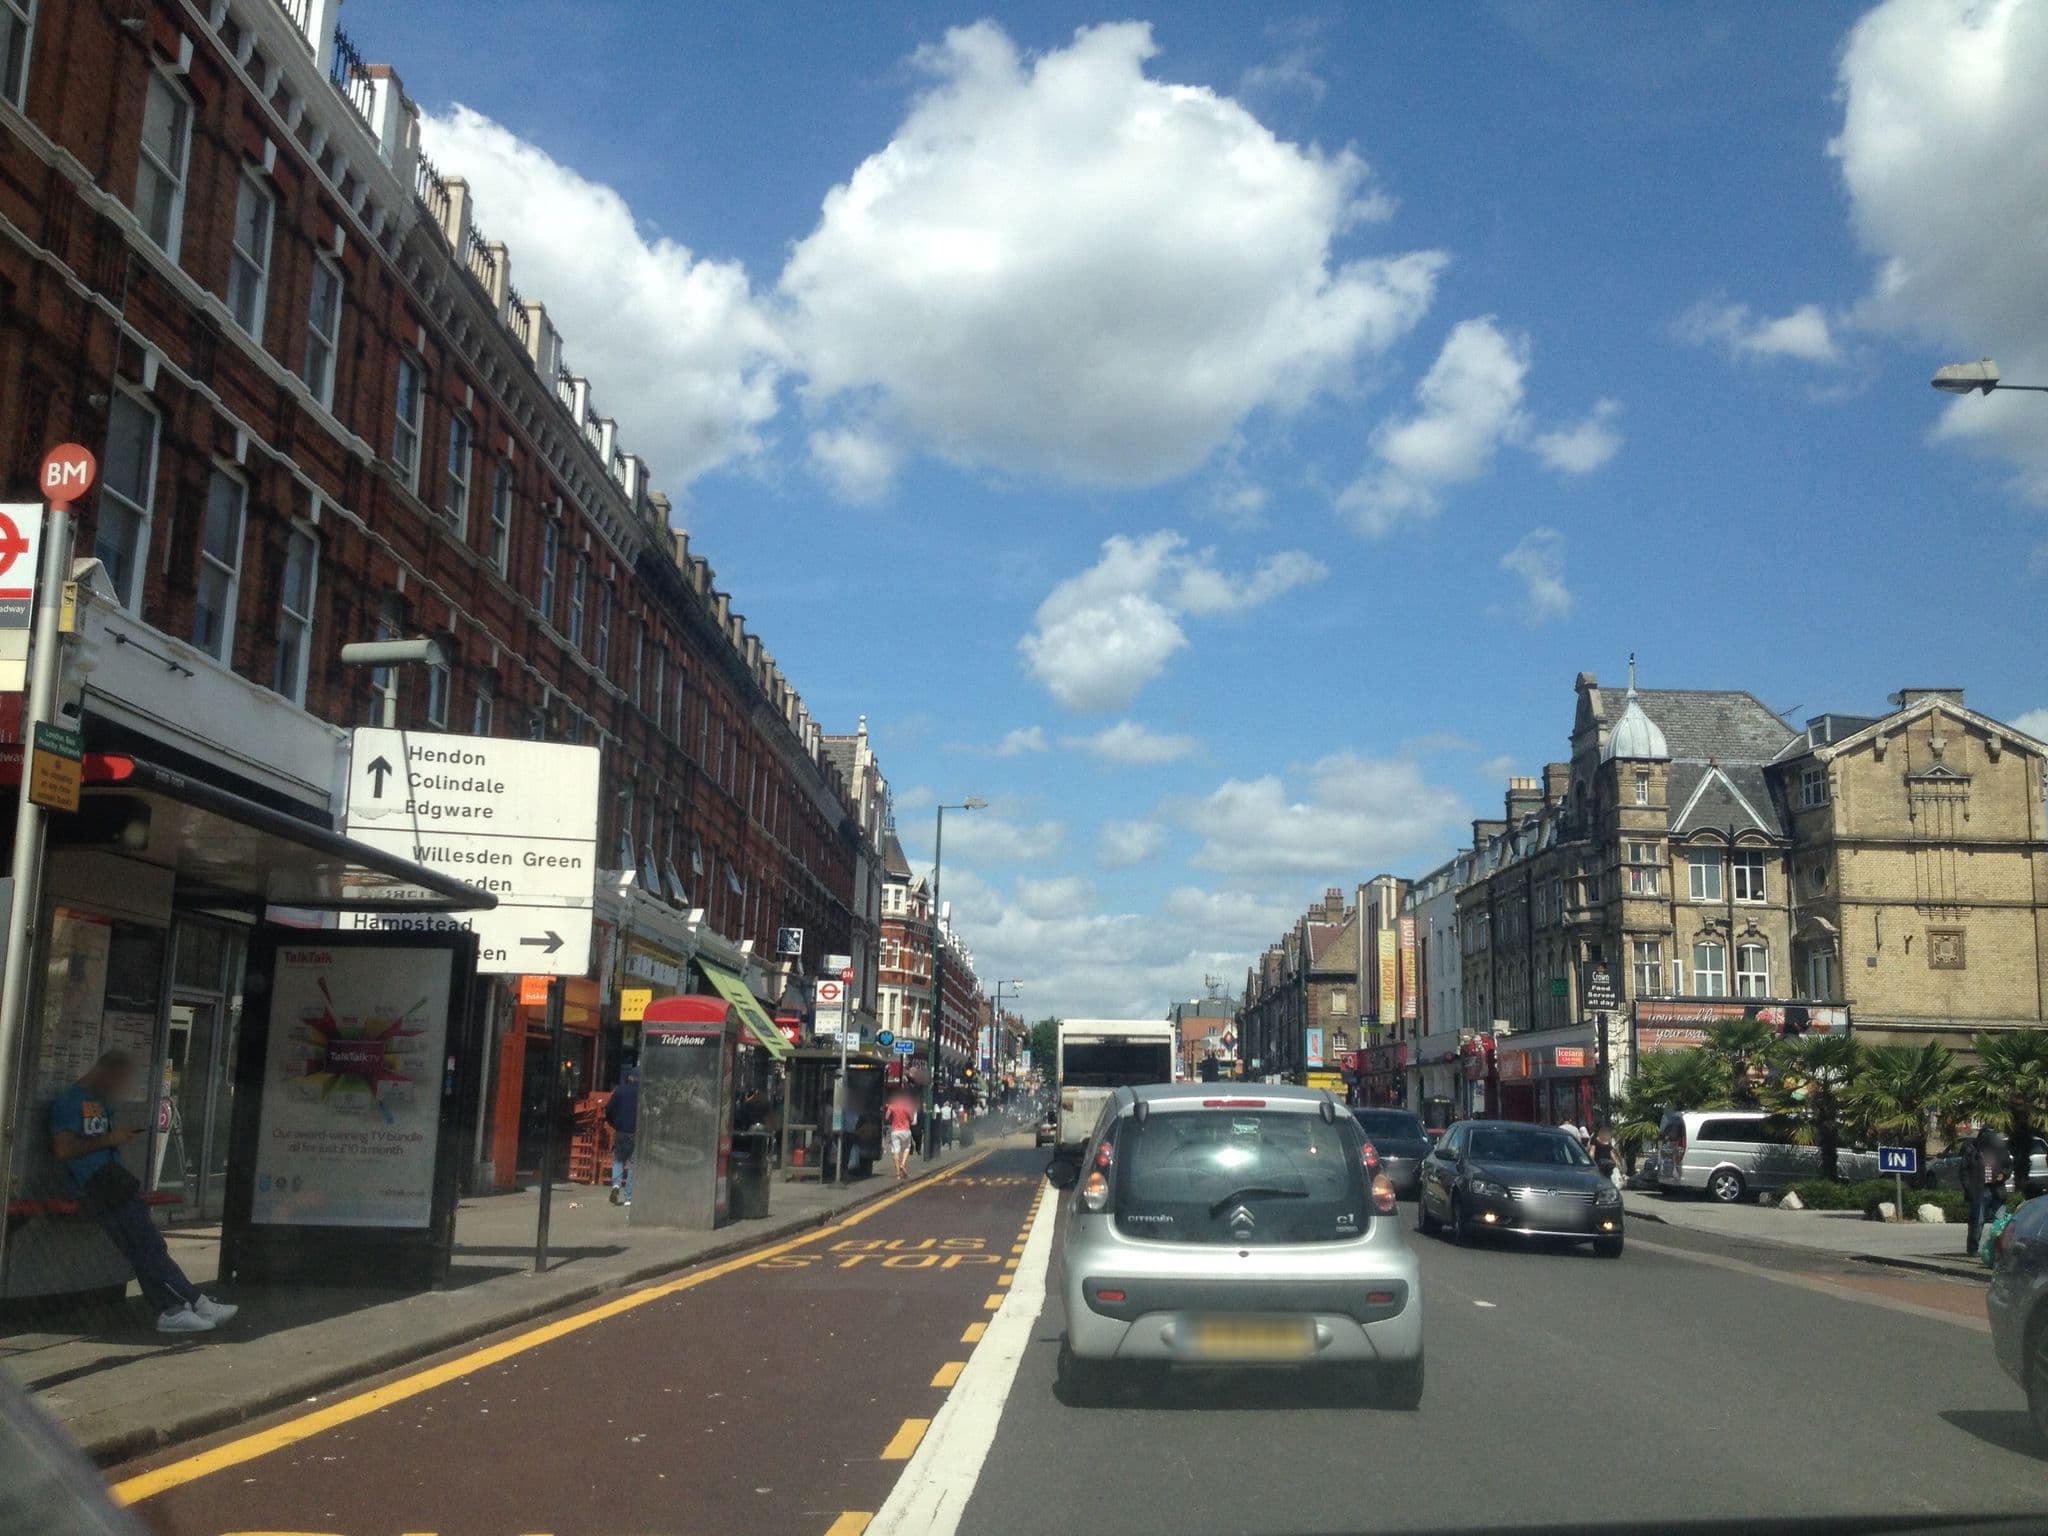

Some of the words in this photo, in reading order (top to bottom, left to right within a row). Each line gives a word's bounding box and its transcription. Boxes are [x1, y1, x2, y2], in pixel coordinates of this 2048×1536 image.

[47, 460, 88, 487] BM
[409, 745, 486, 766] Hendon
[408, 772, 505, 794] Colindale
[405, 799, 494, 819] Edgware
[413, 845, 513, 865] Willesden
[523, 851, 582, 869] Green
[354, 913, 473, 931] Hampstead
[661, 1034, 706, 1046] Telephone
[1654, 1029, 1682, 1046] your
[1888, 1152, 1906, 1167] IN
[829, 1238, 987, 1251] BUS
[756, 1254, 1002, 1269] STOP
